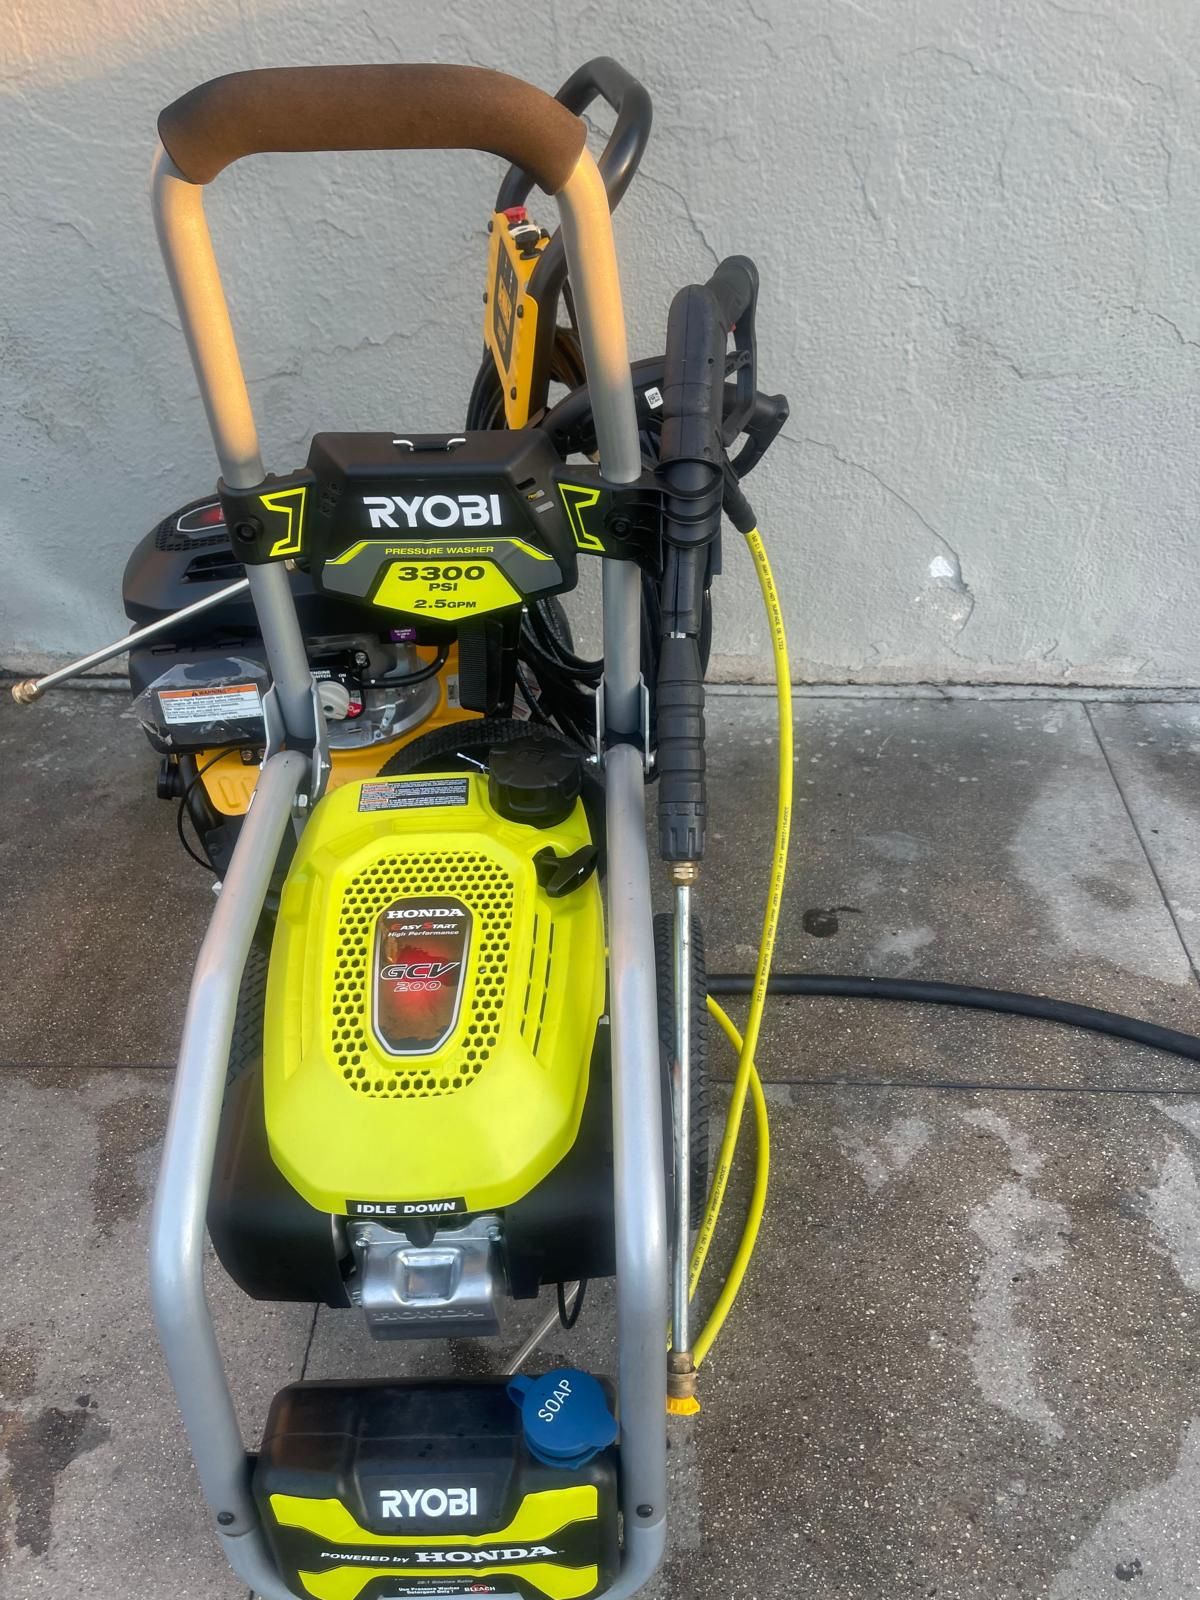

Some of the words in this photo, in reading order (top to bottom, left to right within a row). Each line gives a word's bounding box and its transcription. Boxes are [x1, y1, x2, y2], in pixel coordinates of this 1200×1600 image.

[363, 494, 502, 528] RYOBI
[385, 547, 443, 555] PRESSURE
[446, 546, 495, 554] WASHER
[397, 566, 485, 582] 3300
[428, 583, 458, 592] PSI
[413, 599, 477, 609] 2.5GPM
[387, 908, 465, 920] HONDA
[390, 923, 422, 931] EASY
[422, 921, 459, 930] START
[380, 961, 461, 980] GCV
[393, 980, 442, 993] 200
[356, 1204, 397, 1214] IDLE
[403, 1202, 456, 1214] DOWN
[538, 1379, 572, 1422] SOAP
[379, 1487, 478, 1518] RYOBI
[320, 1552, 390, 1562] POWERED
[392, 1556, 410, 1564] by
[415, 1545, 558, 1563] HONDA
